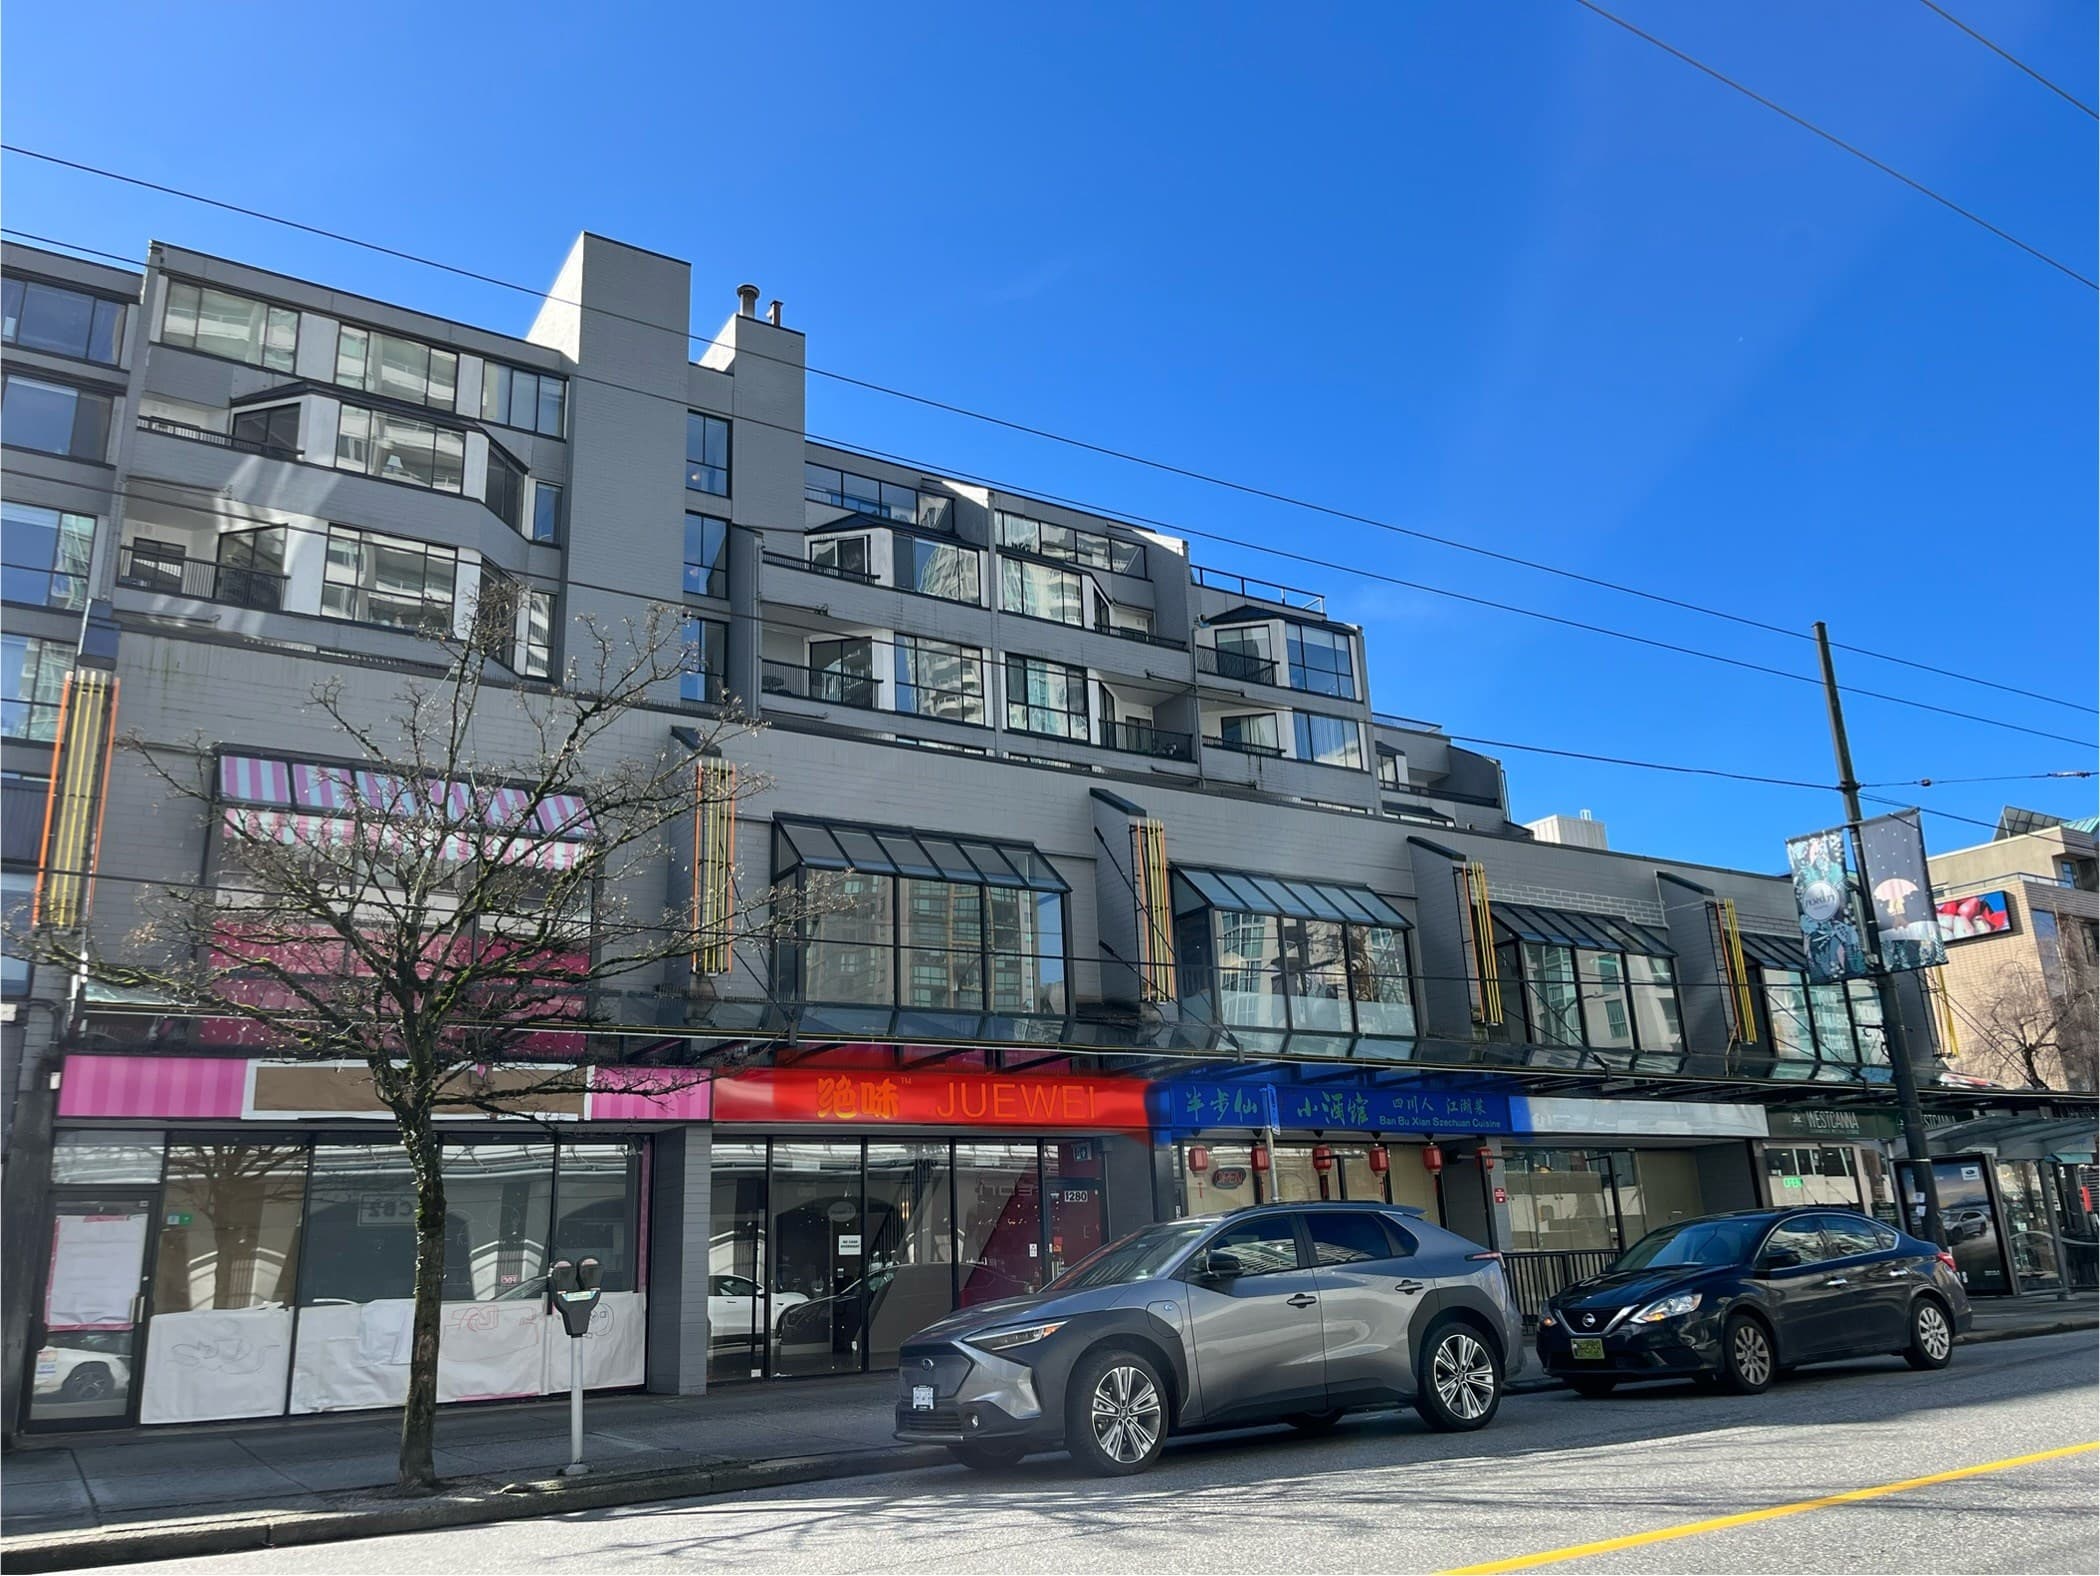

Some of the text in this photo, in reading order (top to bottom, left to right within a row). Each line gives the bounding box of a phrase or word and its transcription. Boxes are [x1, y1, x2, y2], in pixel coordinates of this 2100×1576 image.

[816, 1074, 899, 1119] 绝味
[936, 1082, 1095, 1119] JUEWEI
[1392, 1096, 1434, 1114] 四川人
[1379, 1115, 1501, 1128] Ban Bu Xian Szechuan Cuisine
[1806, 1111, 1860, 1129] WESTCANNA
[1215, 1170, 1244, 1186] OPEN
[1783, 1177, 1803, 1189] OPEN
[1064, 1190, 1088, 1202] 1280
